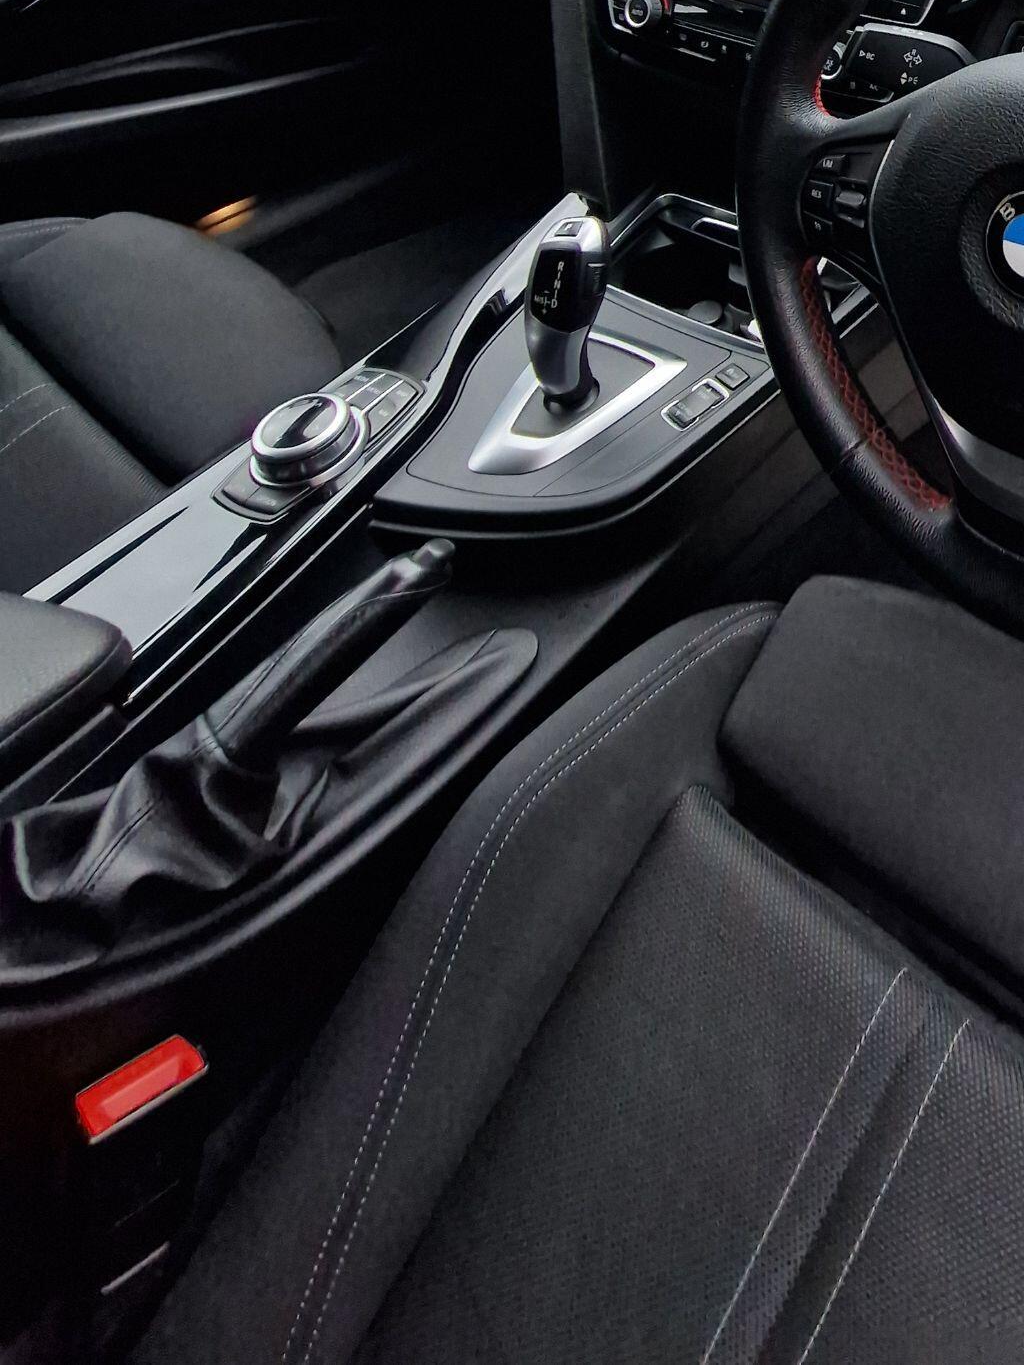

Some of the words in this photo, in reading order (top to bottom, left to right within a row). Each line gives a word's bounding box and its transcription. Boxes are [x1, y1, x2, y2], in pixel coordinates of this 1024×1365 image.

[558, 261, 564, 271] R
[554, 279, 561, 289] N
[551, 299, 558, 308] D
